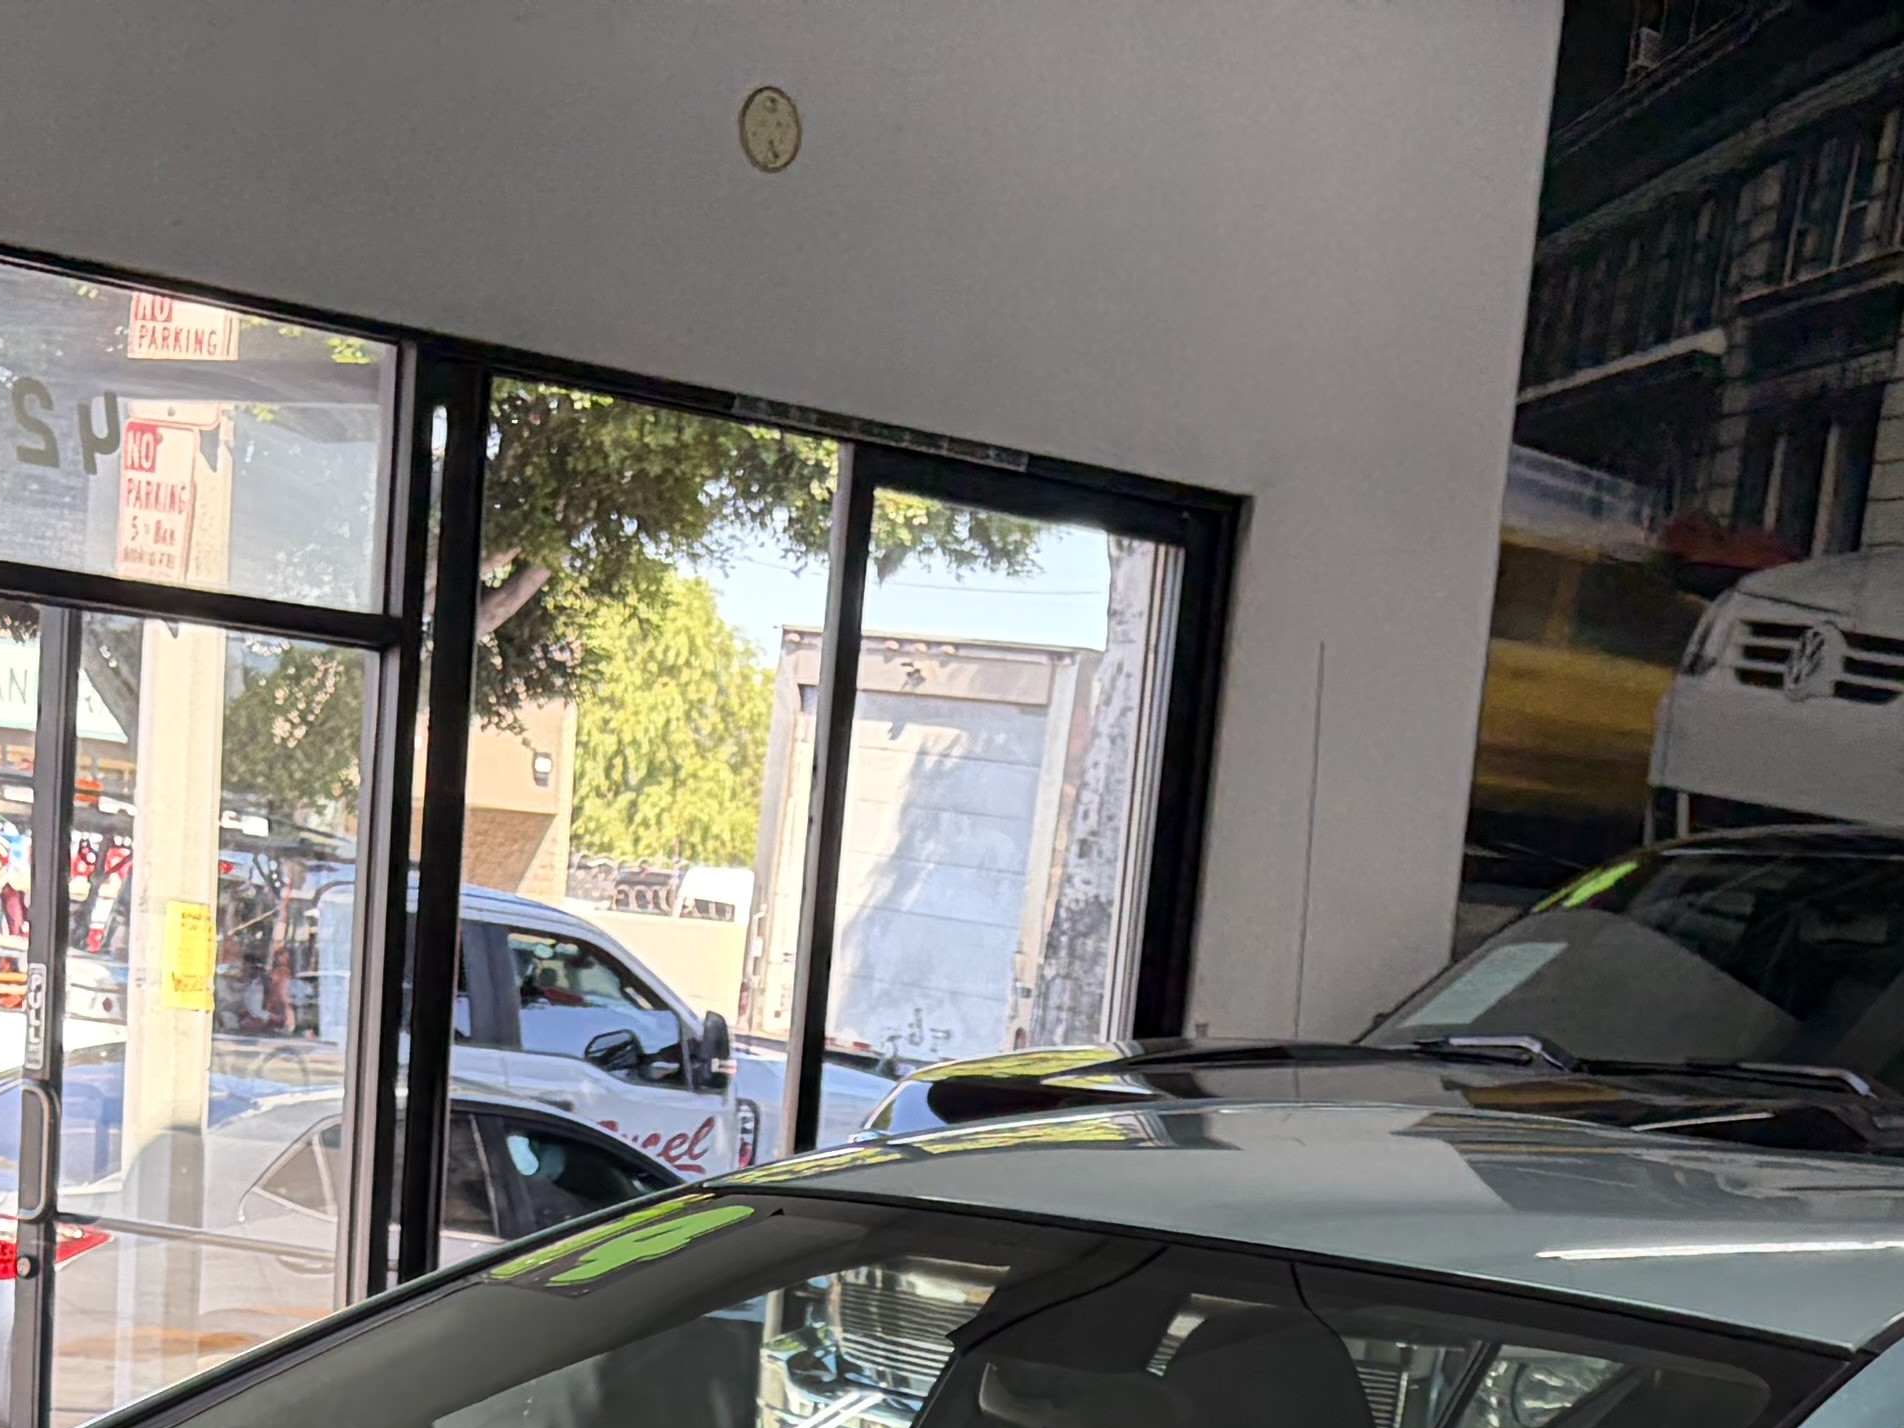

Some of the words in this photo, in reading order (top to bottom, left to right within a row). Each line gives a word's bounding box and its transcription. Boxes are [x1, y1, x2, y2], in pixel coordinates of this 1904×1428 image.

[138, 325, 218, 357] PARKING
[127, 431, 155, 471] NO
[126, 478, 188, 514] PARKING
